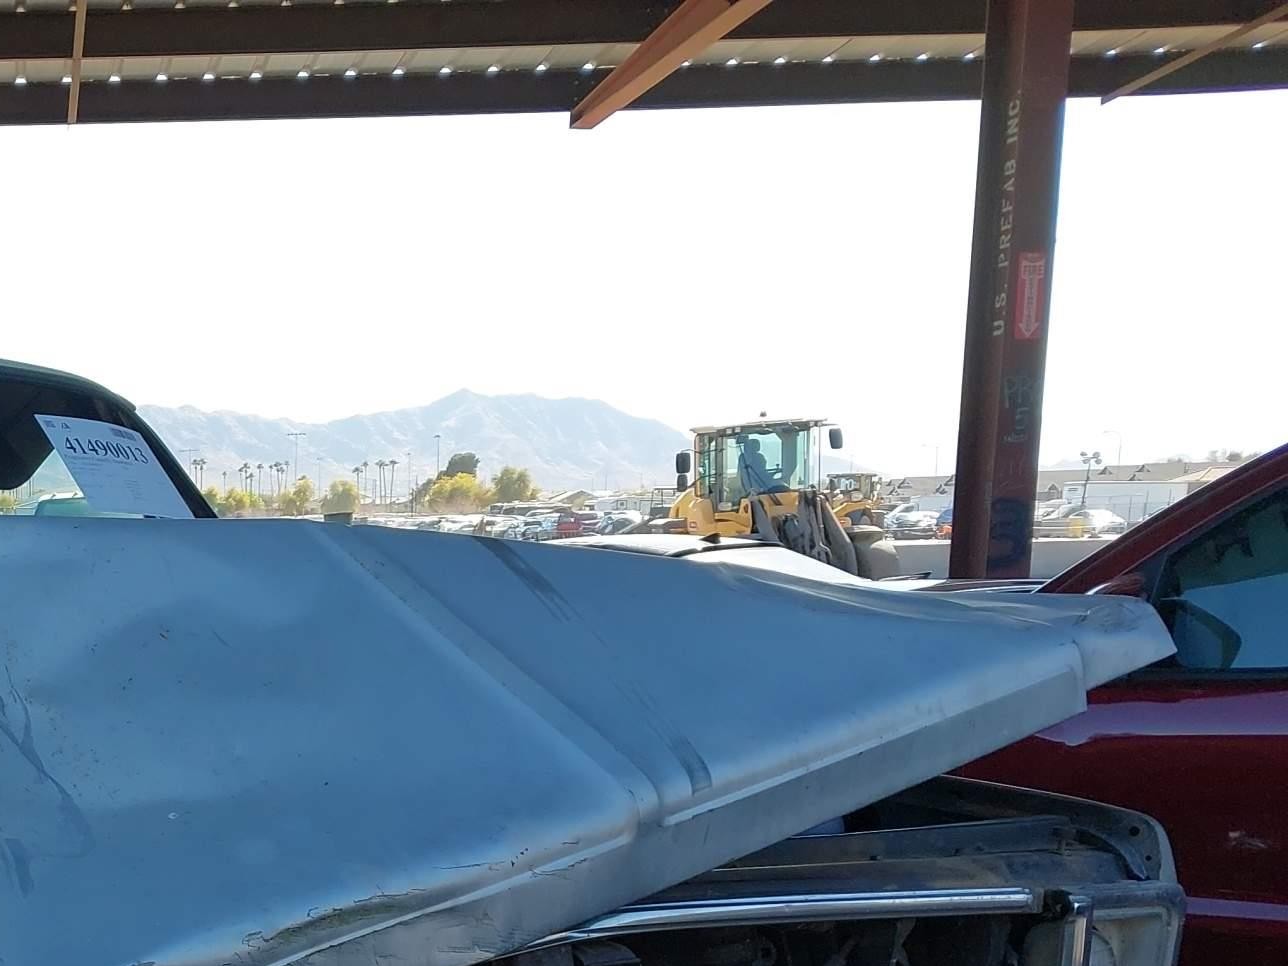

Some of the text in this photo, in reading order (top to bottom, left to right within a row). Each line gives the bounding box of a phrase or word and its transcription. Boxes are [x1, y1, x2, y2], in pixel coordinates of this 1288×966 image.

[992, 89, 1021, 336] U.S. PREFAB INC.
[65, 436, 149, 464] 41490013
